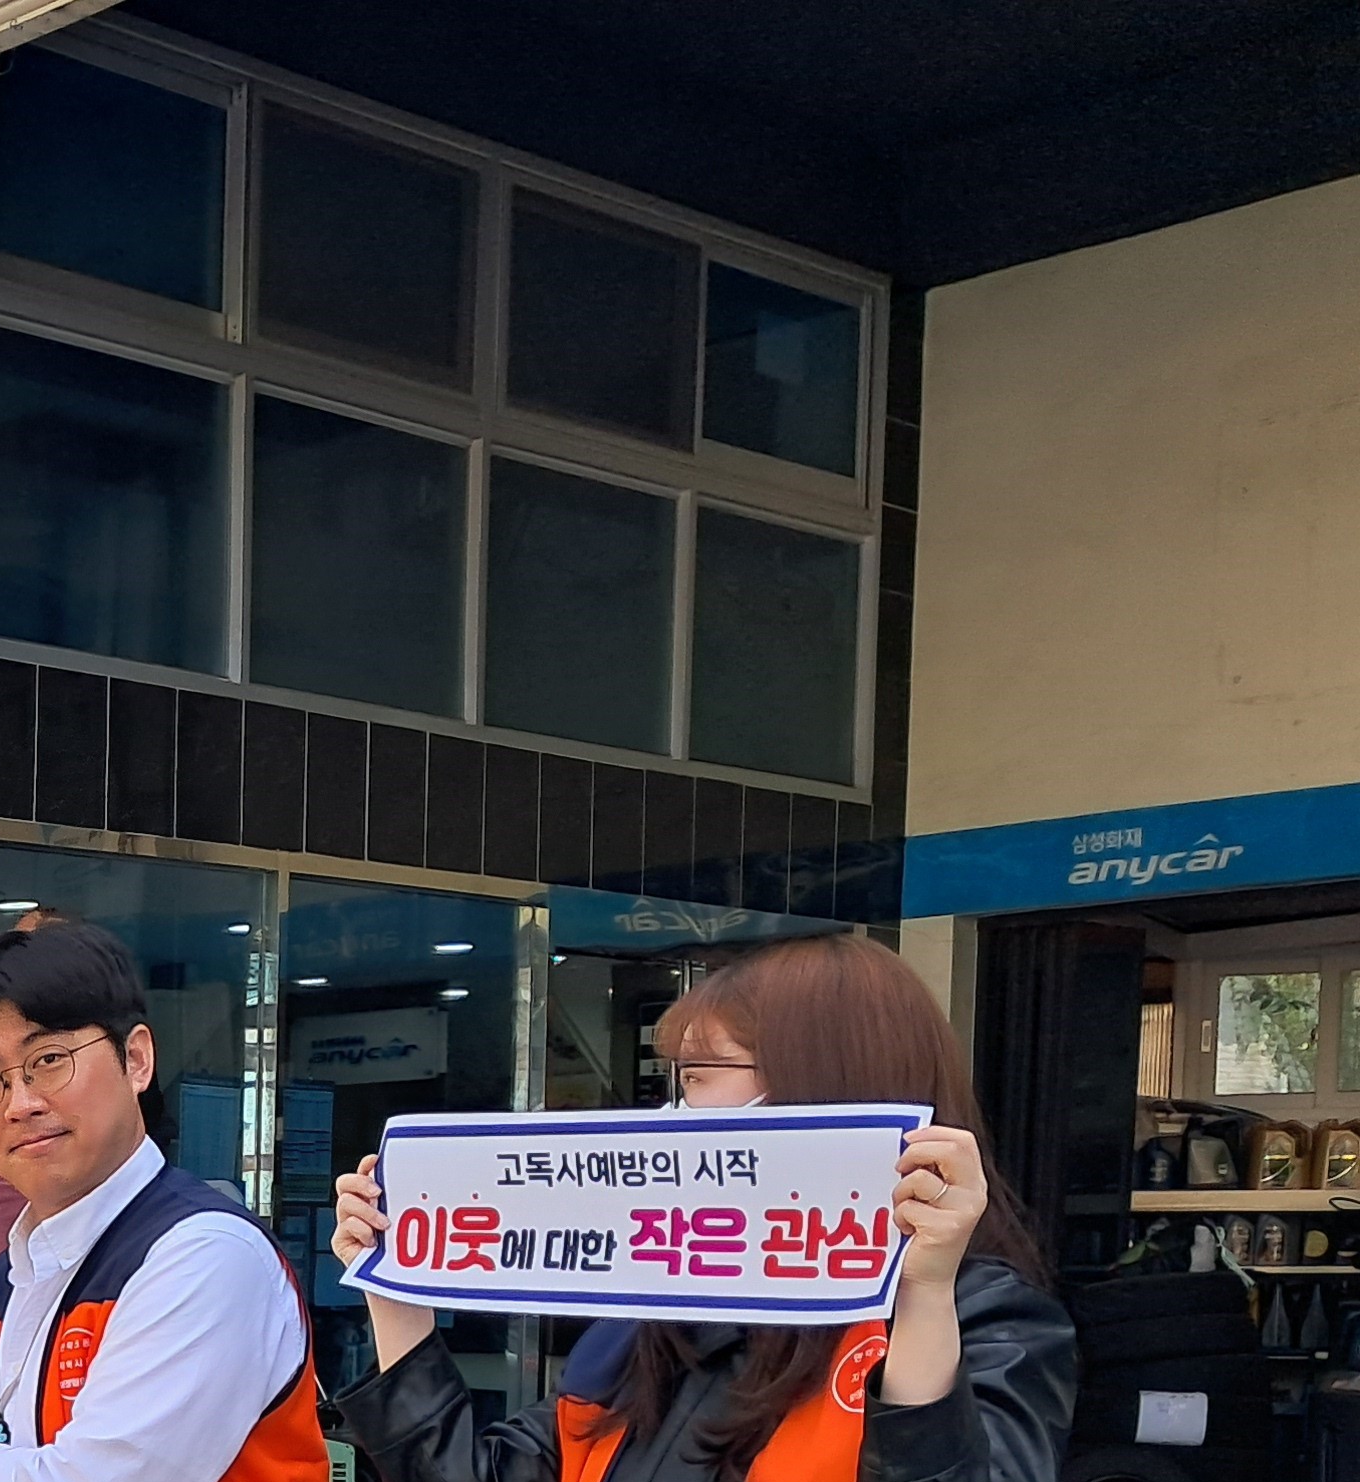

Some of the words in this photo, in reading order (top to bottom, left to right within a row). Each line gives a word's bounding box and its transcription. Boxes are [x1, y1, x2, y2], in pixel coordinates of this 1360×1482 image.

[1072, 827, 1142, 854] 삼성화재
[497, 1151, 681, 1188] 고독사예방의
[694, 1150, 759, 1188] 시작
[395, 1205, 535, 1273] 이웃에
[544, 1228, 617, 1273] 대한
[629, 1206, 747, 1276] 작은
[763, 1205, 890, 1280] 관심
